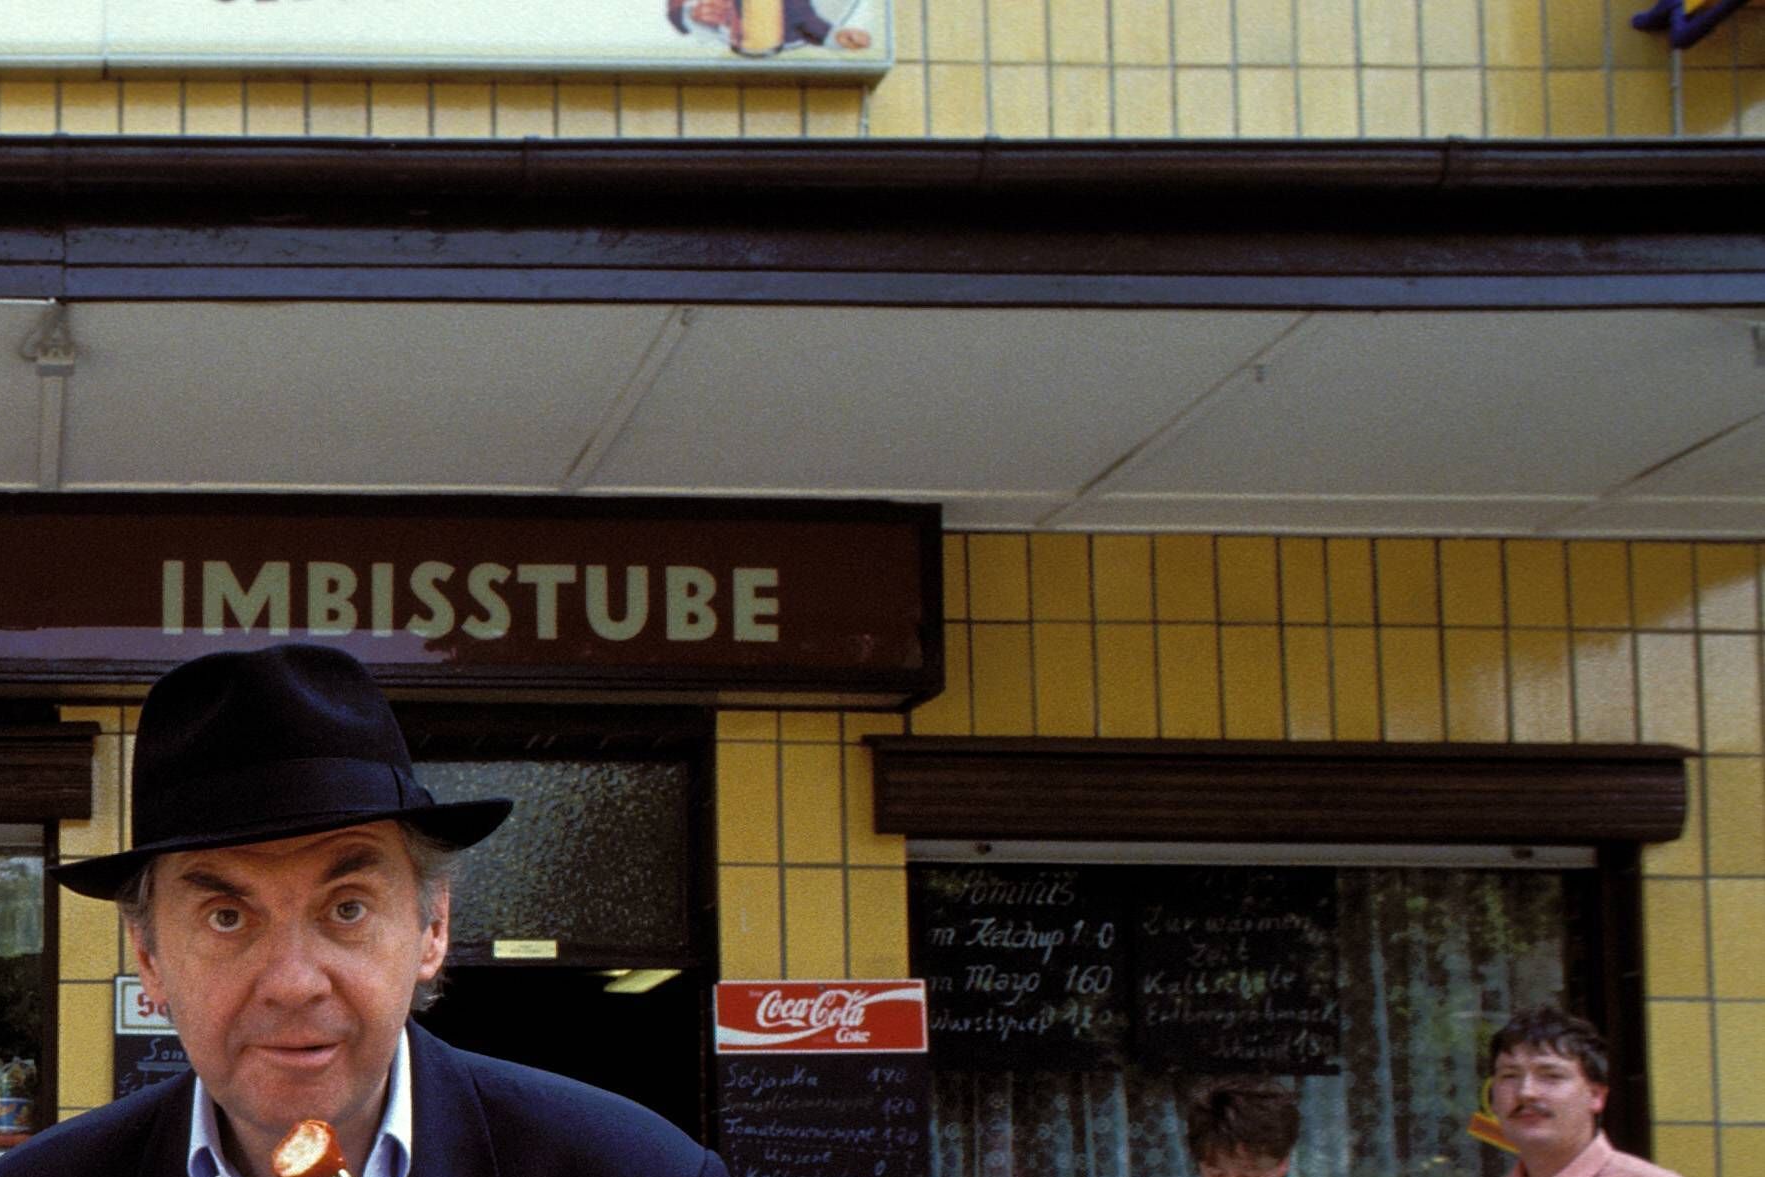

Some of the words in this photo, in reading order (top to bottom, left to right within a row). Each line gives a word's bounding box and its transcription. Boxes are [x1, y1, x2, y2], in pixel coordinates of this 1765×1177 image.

[162, 559, 779, 642] IMBISSTUBE
[965, 917, 1065, 965] Ketchup
[756, 989, 869, 1027] Coca-Cola
[965, 963, 1041, 1007] Mayo
